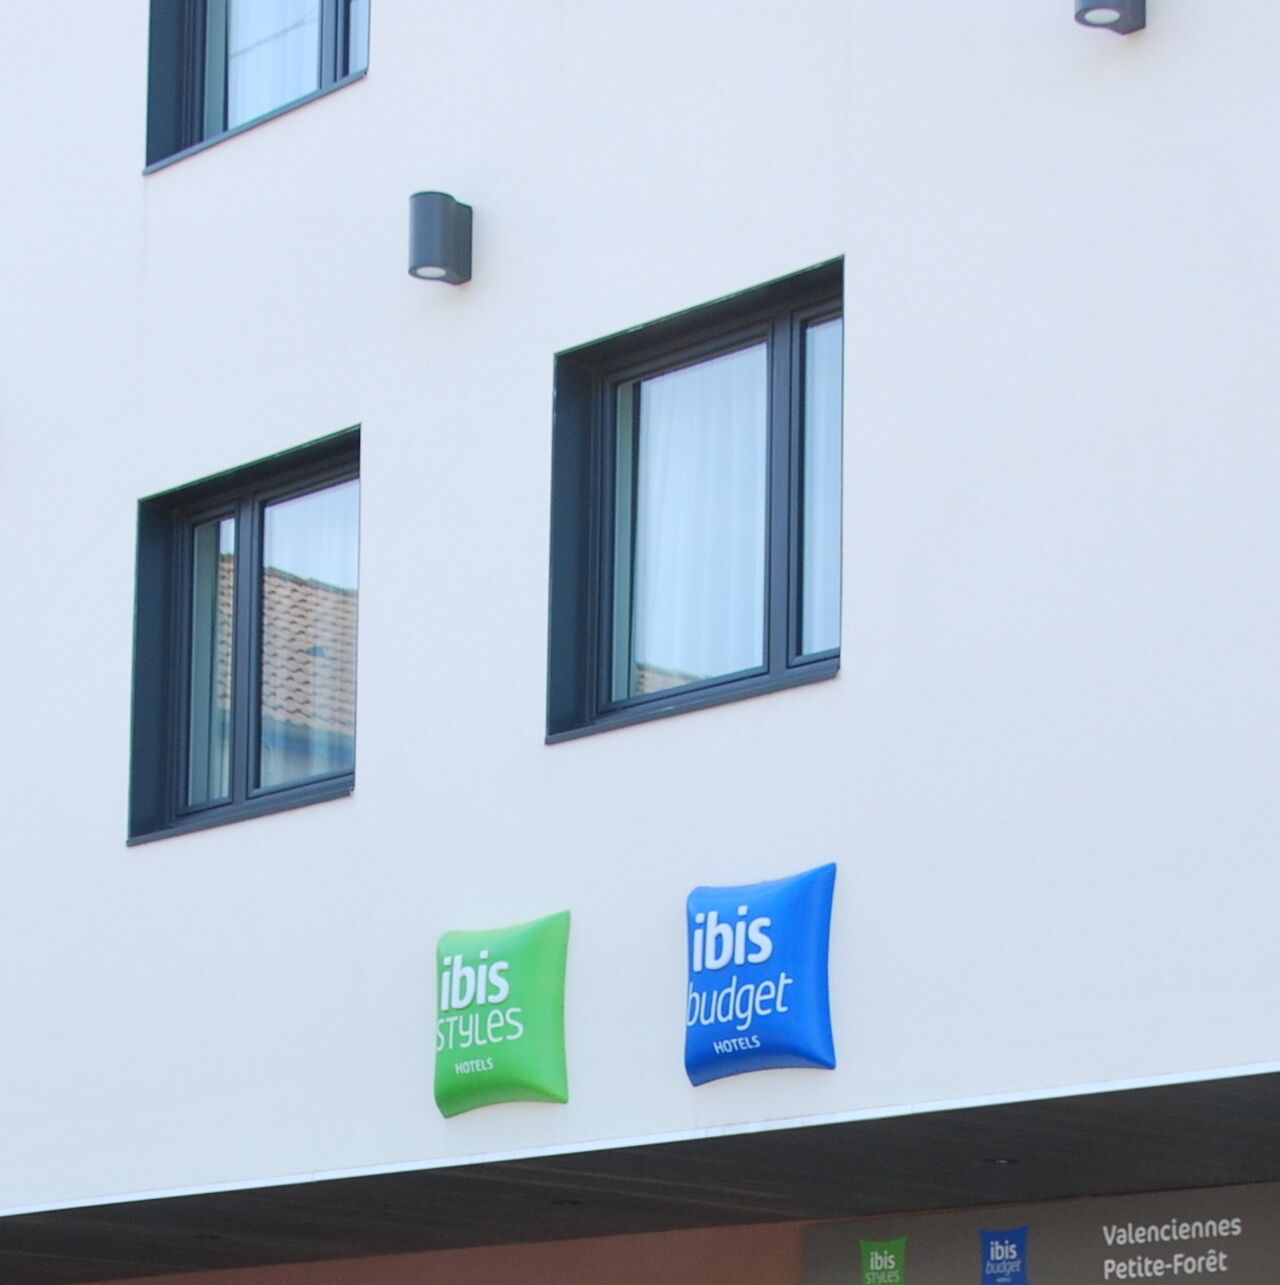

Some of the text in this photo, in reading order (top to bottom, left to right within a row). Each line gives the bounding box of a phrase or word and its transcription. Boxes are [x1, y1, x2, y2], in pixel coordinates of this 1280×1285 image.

[693, 905, 773, 973] ibis
[440, 950, 510, 1011] ibis
[687, 972, 793, 1031] budget
[713, 1035, 761, 1055] HOTELS
[455, 1057, 494, 1075] HOTELS
[1102, 1218, 1242, 1246] Valenciennes
[869, 1250, 896, 1271] ibis
[990, 1239, 1017, 1261] ibis
[985, 1259, 1022, 1277] budget
[1104, 1248, 1228, 1280] Petite-Forêt
